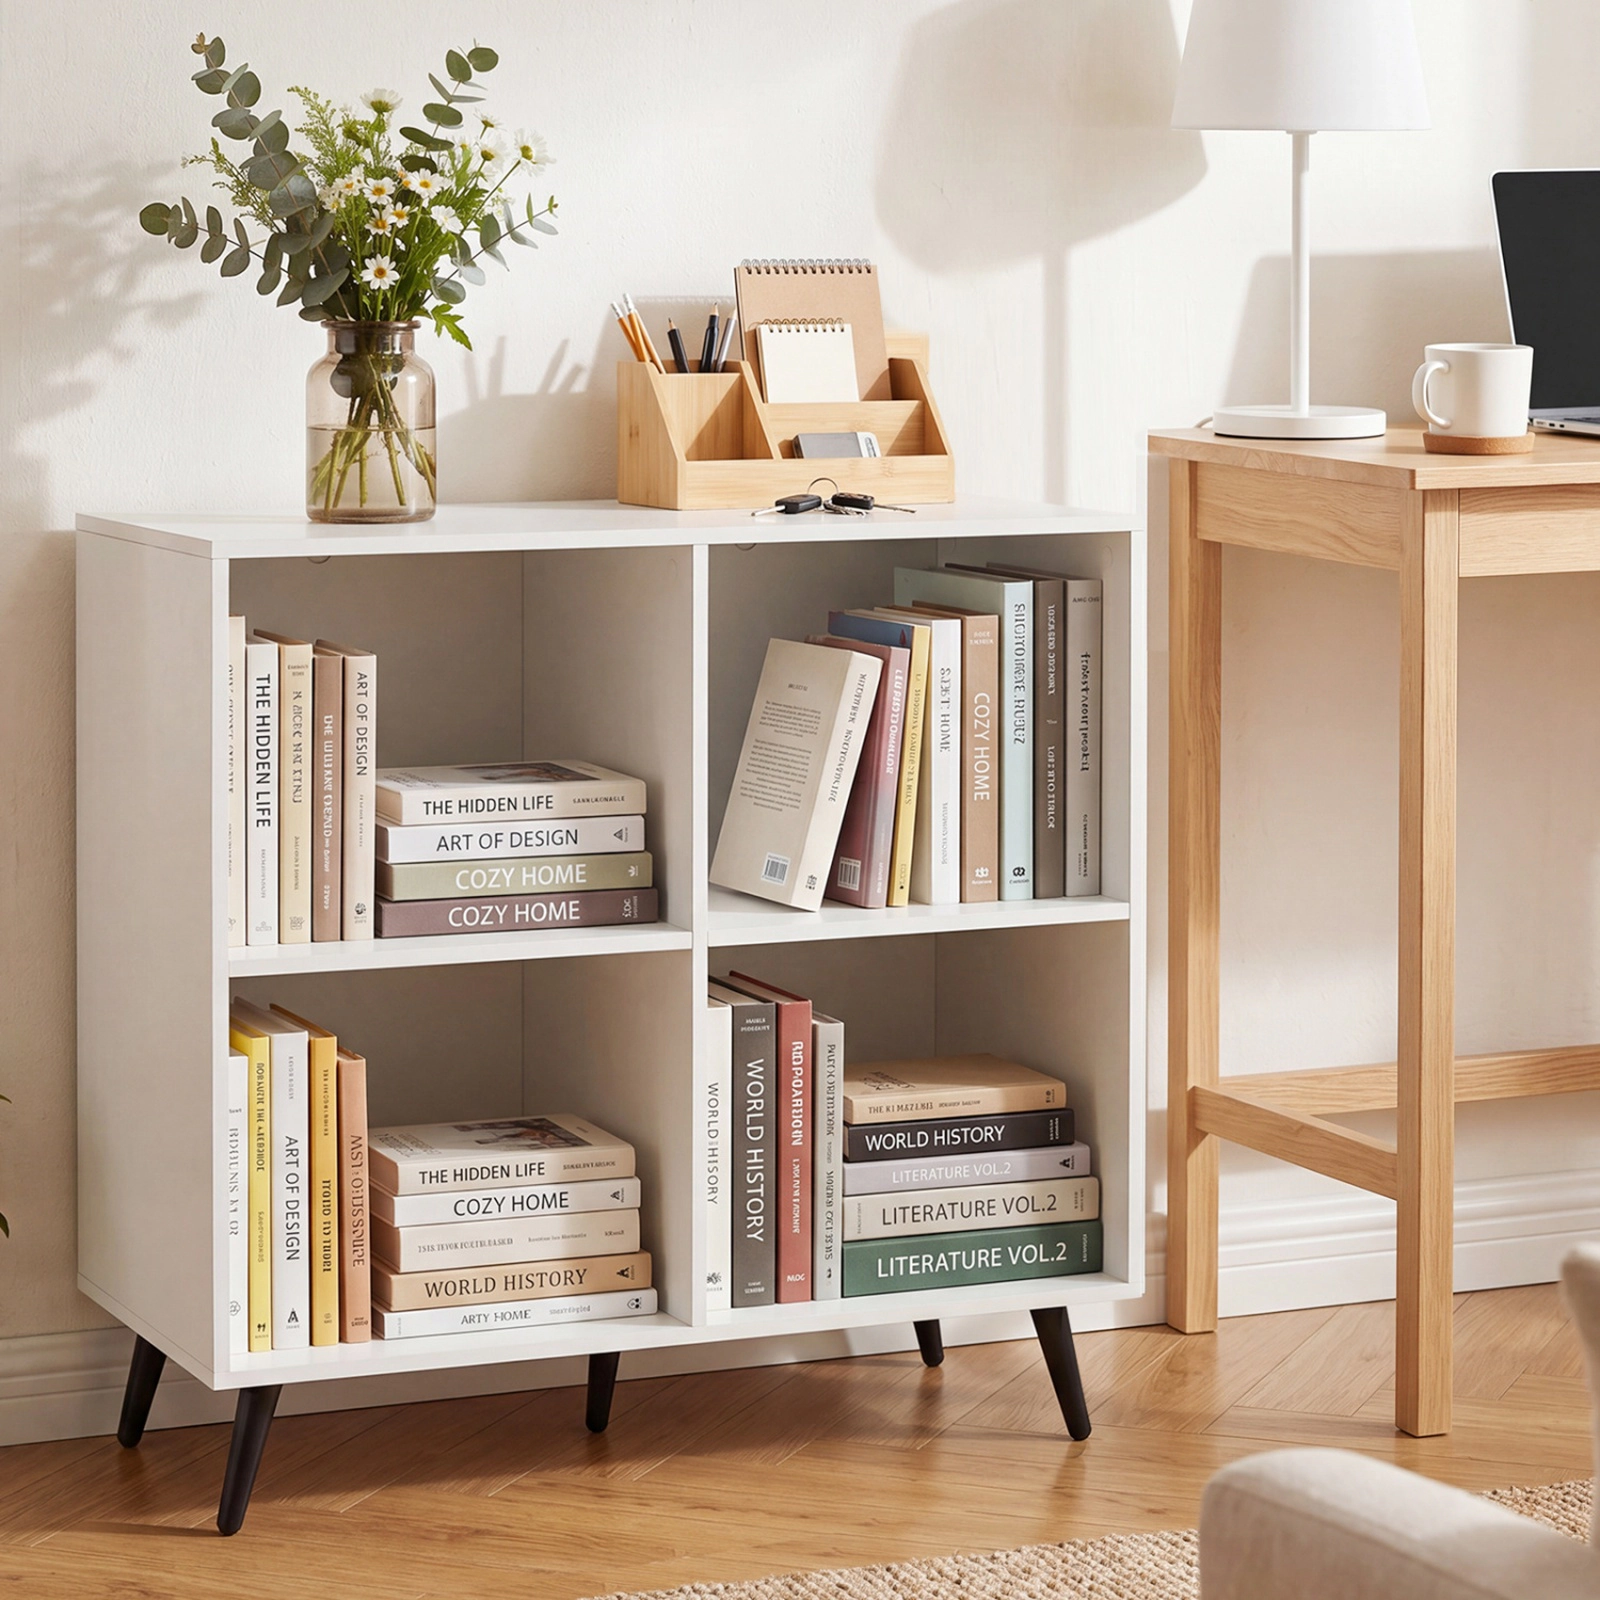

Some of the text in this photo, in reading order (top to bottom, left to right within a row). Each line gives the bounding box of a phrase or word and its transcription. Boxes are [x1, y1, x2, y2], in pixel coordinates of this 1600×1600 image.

[356, 672, 368, 776] ART OF DESIGN
[256, 674, 271, 828] THE HIDDEN LIFE
[974, 692, 990, 801] COZY HOME
[423, 795, 554, 816] THE HIDDEN LIFE
[436, 829, 578, 851] ART OF DESIGN
[455, 864, 586, 890] COZY HOME
[448, 900, 580, 927] COZY HOME
[707, 1082, 719, 1139] WORLD
[746, 1058, 764, 1242] WORLD HISTORY
[865, 1125, 1006, 1151] WORLD HISTORY
[419, 1169, 448, 1185] THE
[453, 1164, 510, 1182] HIDDEN
[515, 1161, 545, 1178] LIFE
[892, 1162, 1012, 1184] LITERATURE VOL.2
[285, 1135, 300, 1261] ART OF DESIGN
[453, 1191, 569, 1217] COZY HOME
[882, 1194, 1057, 1226] LITERATURE VOL.2
[877, 1242, 1067, 1278] LITERATURE VOL.2
[424, 1268, 588, 1298] WORLD HISTORY
[461, 1312, 490, 1325] ARTY
